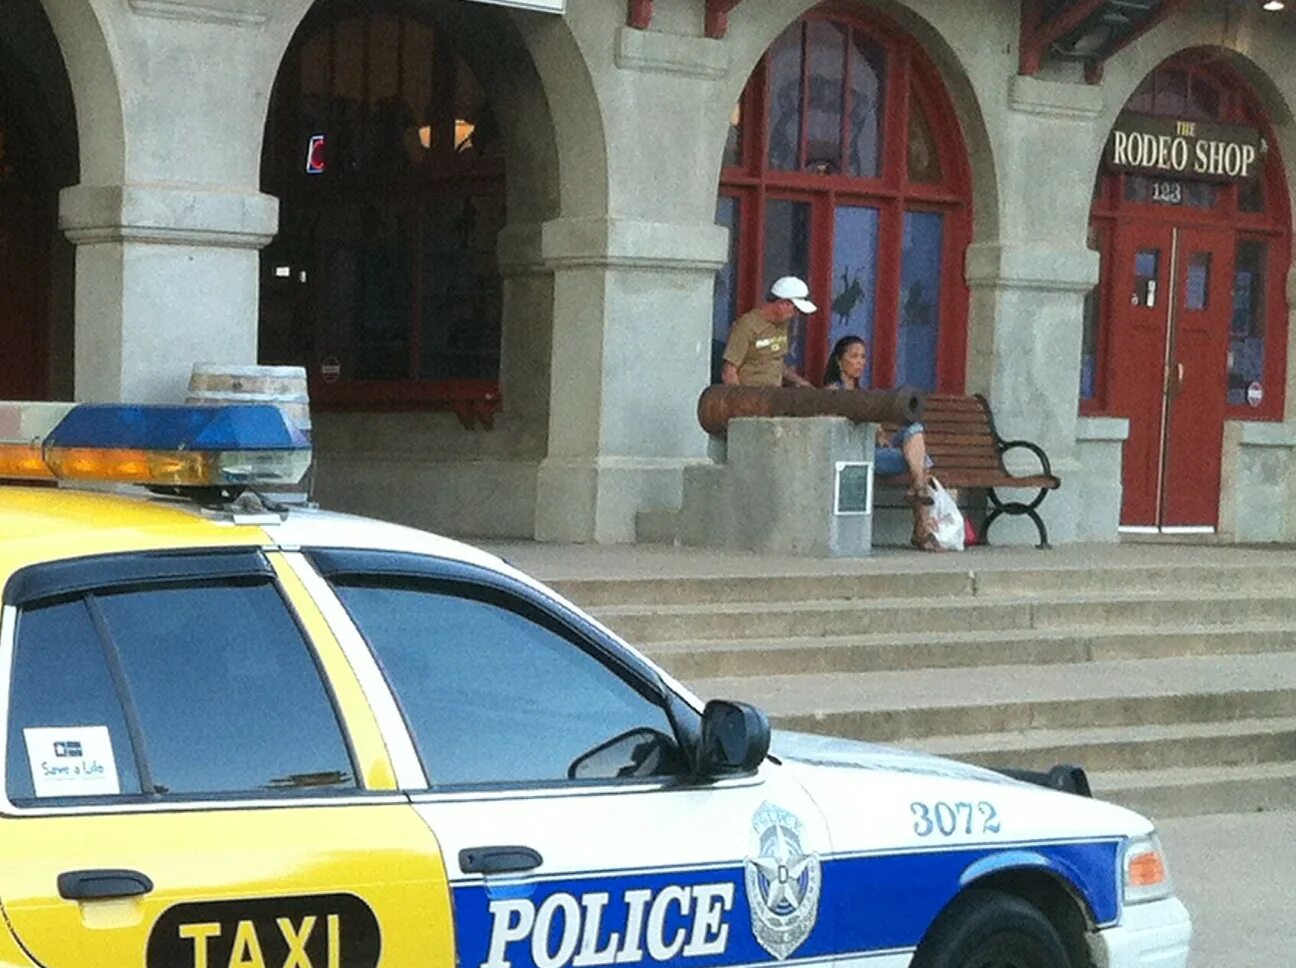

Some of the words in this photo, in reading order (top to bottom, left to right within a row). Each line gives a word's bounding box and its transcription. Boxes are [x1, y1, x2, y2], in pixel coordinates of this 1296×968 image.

[1176, 121, 1196, 137] THE
[1114, 131, 1188, 171] RODEO
[1194, 139, 1255, 176] SHOP
[41, 761, 70, 776] Save
[910, 801, 1001, 837] 3072
